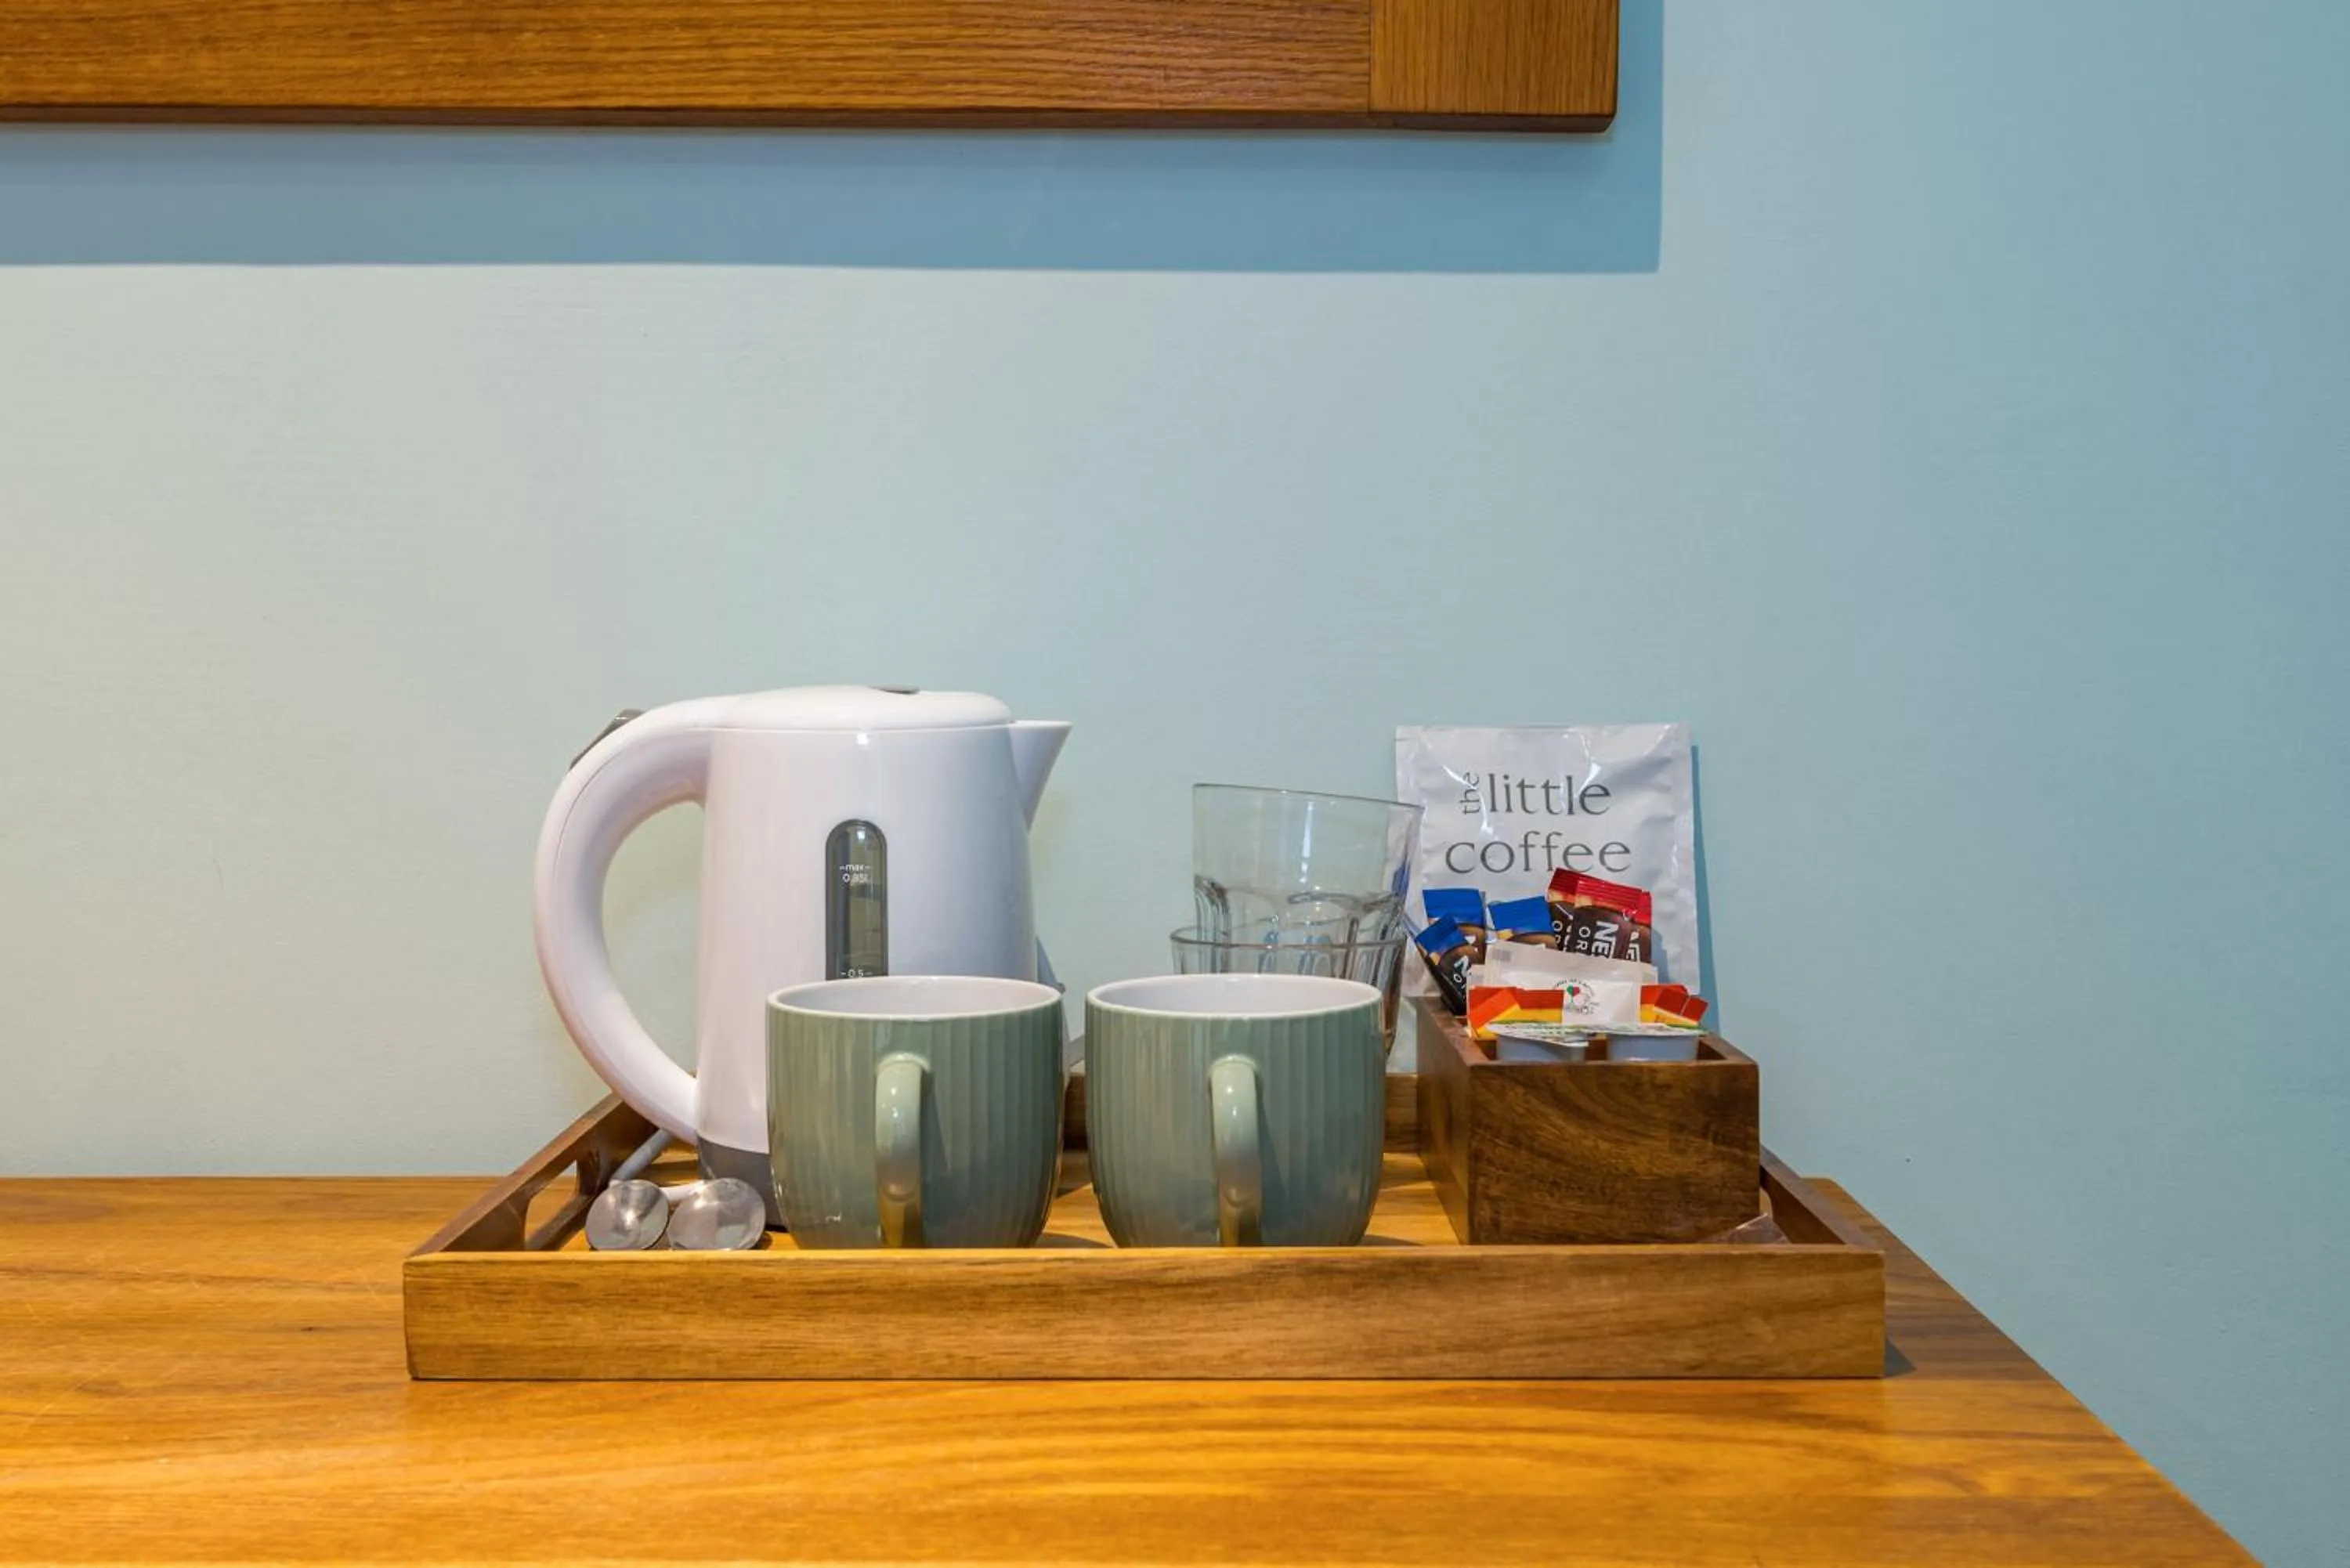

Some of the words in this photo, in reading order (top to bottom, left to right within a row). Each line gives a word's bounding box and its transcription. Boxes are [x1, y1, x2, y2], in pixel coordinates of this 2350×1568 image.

[1459, 771, 1480, 815] the
[1488, 773, 1611, 815] little
[1445, 830, 1631, 874] coffee
